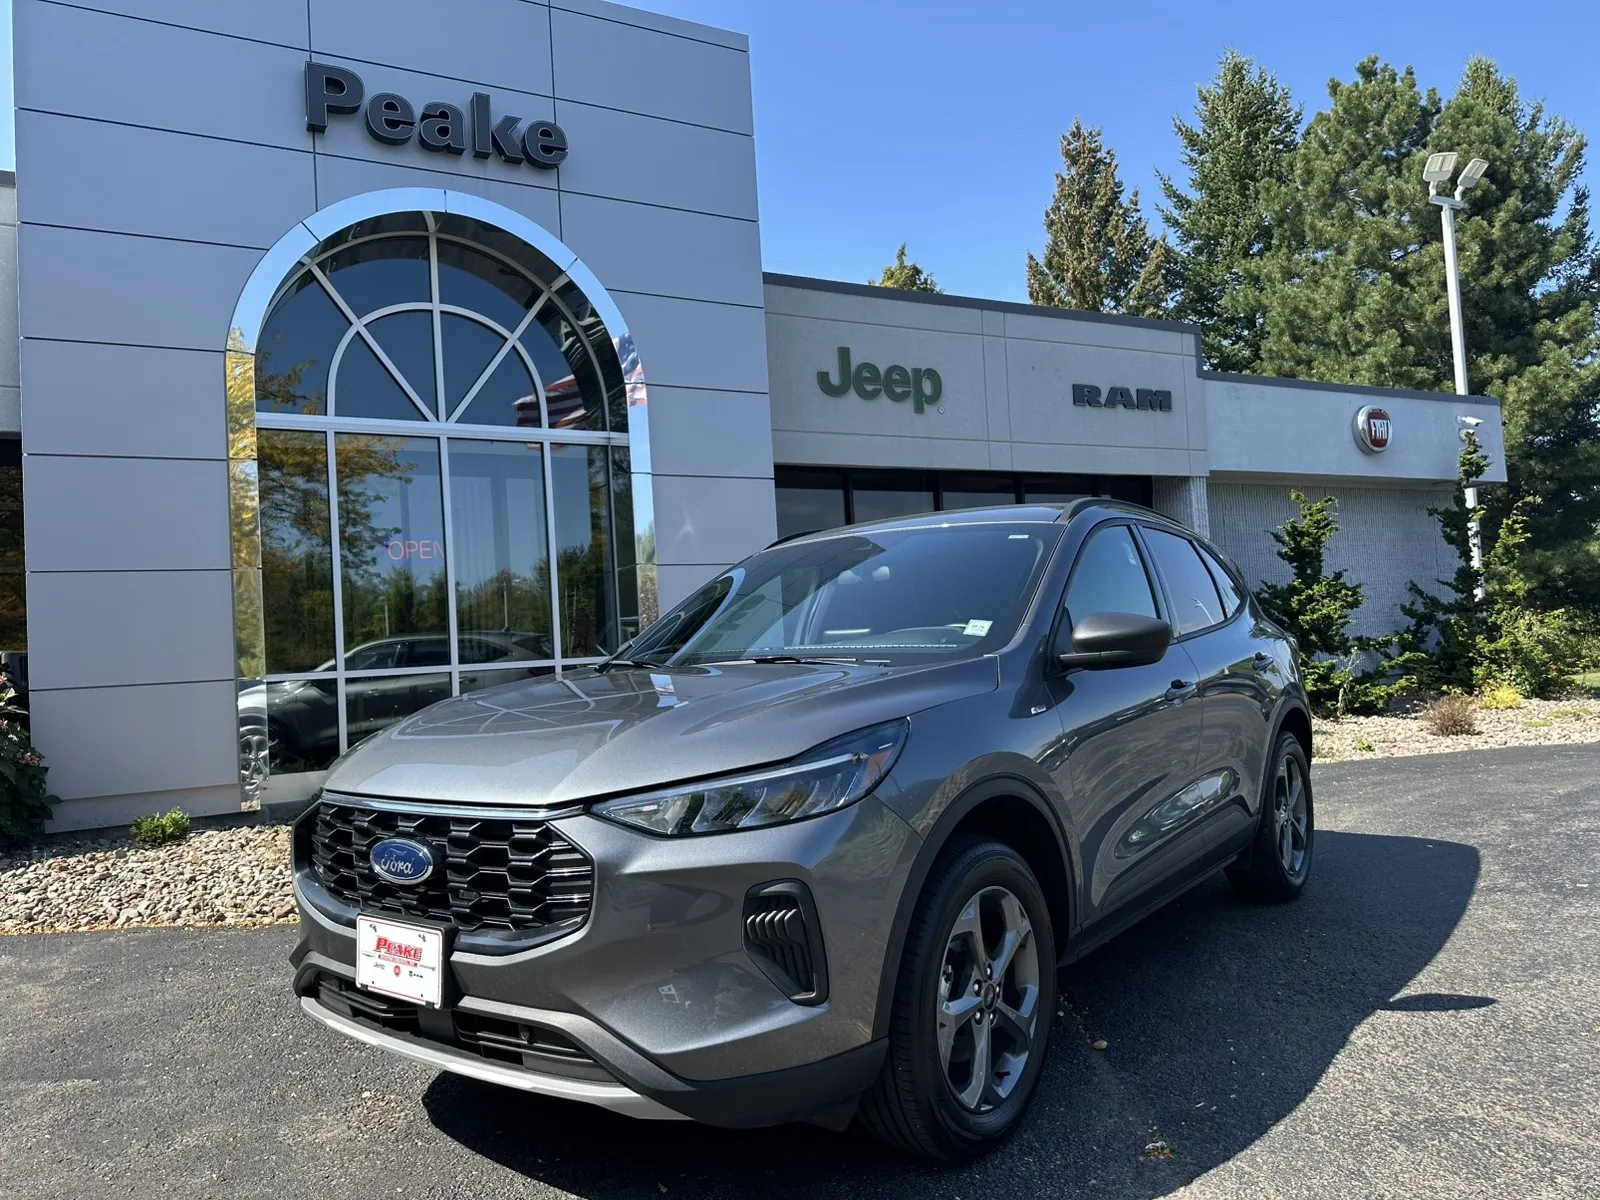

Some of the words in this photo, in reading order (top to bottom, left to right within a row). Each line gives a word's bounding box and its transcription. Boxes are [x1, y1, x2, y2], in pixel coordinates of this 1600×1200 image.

[304, 61, 569, 169] Peake
[817, 346, 942, 413] Jeep
[1072, 383, 1172, 411] RAM
[1369, 418, 1388, 440] FIAT
[387, 540, 445, 560] OPEN
[380, 847, 416, 874] Ford
